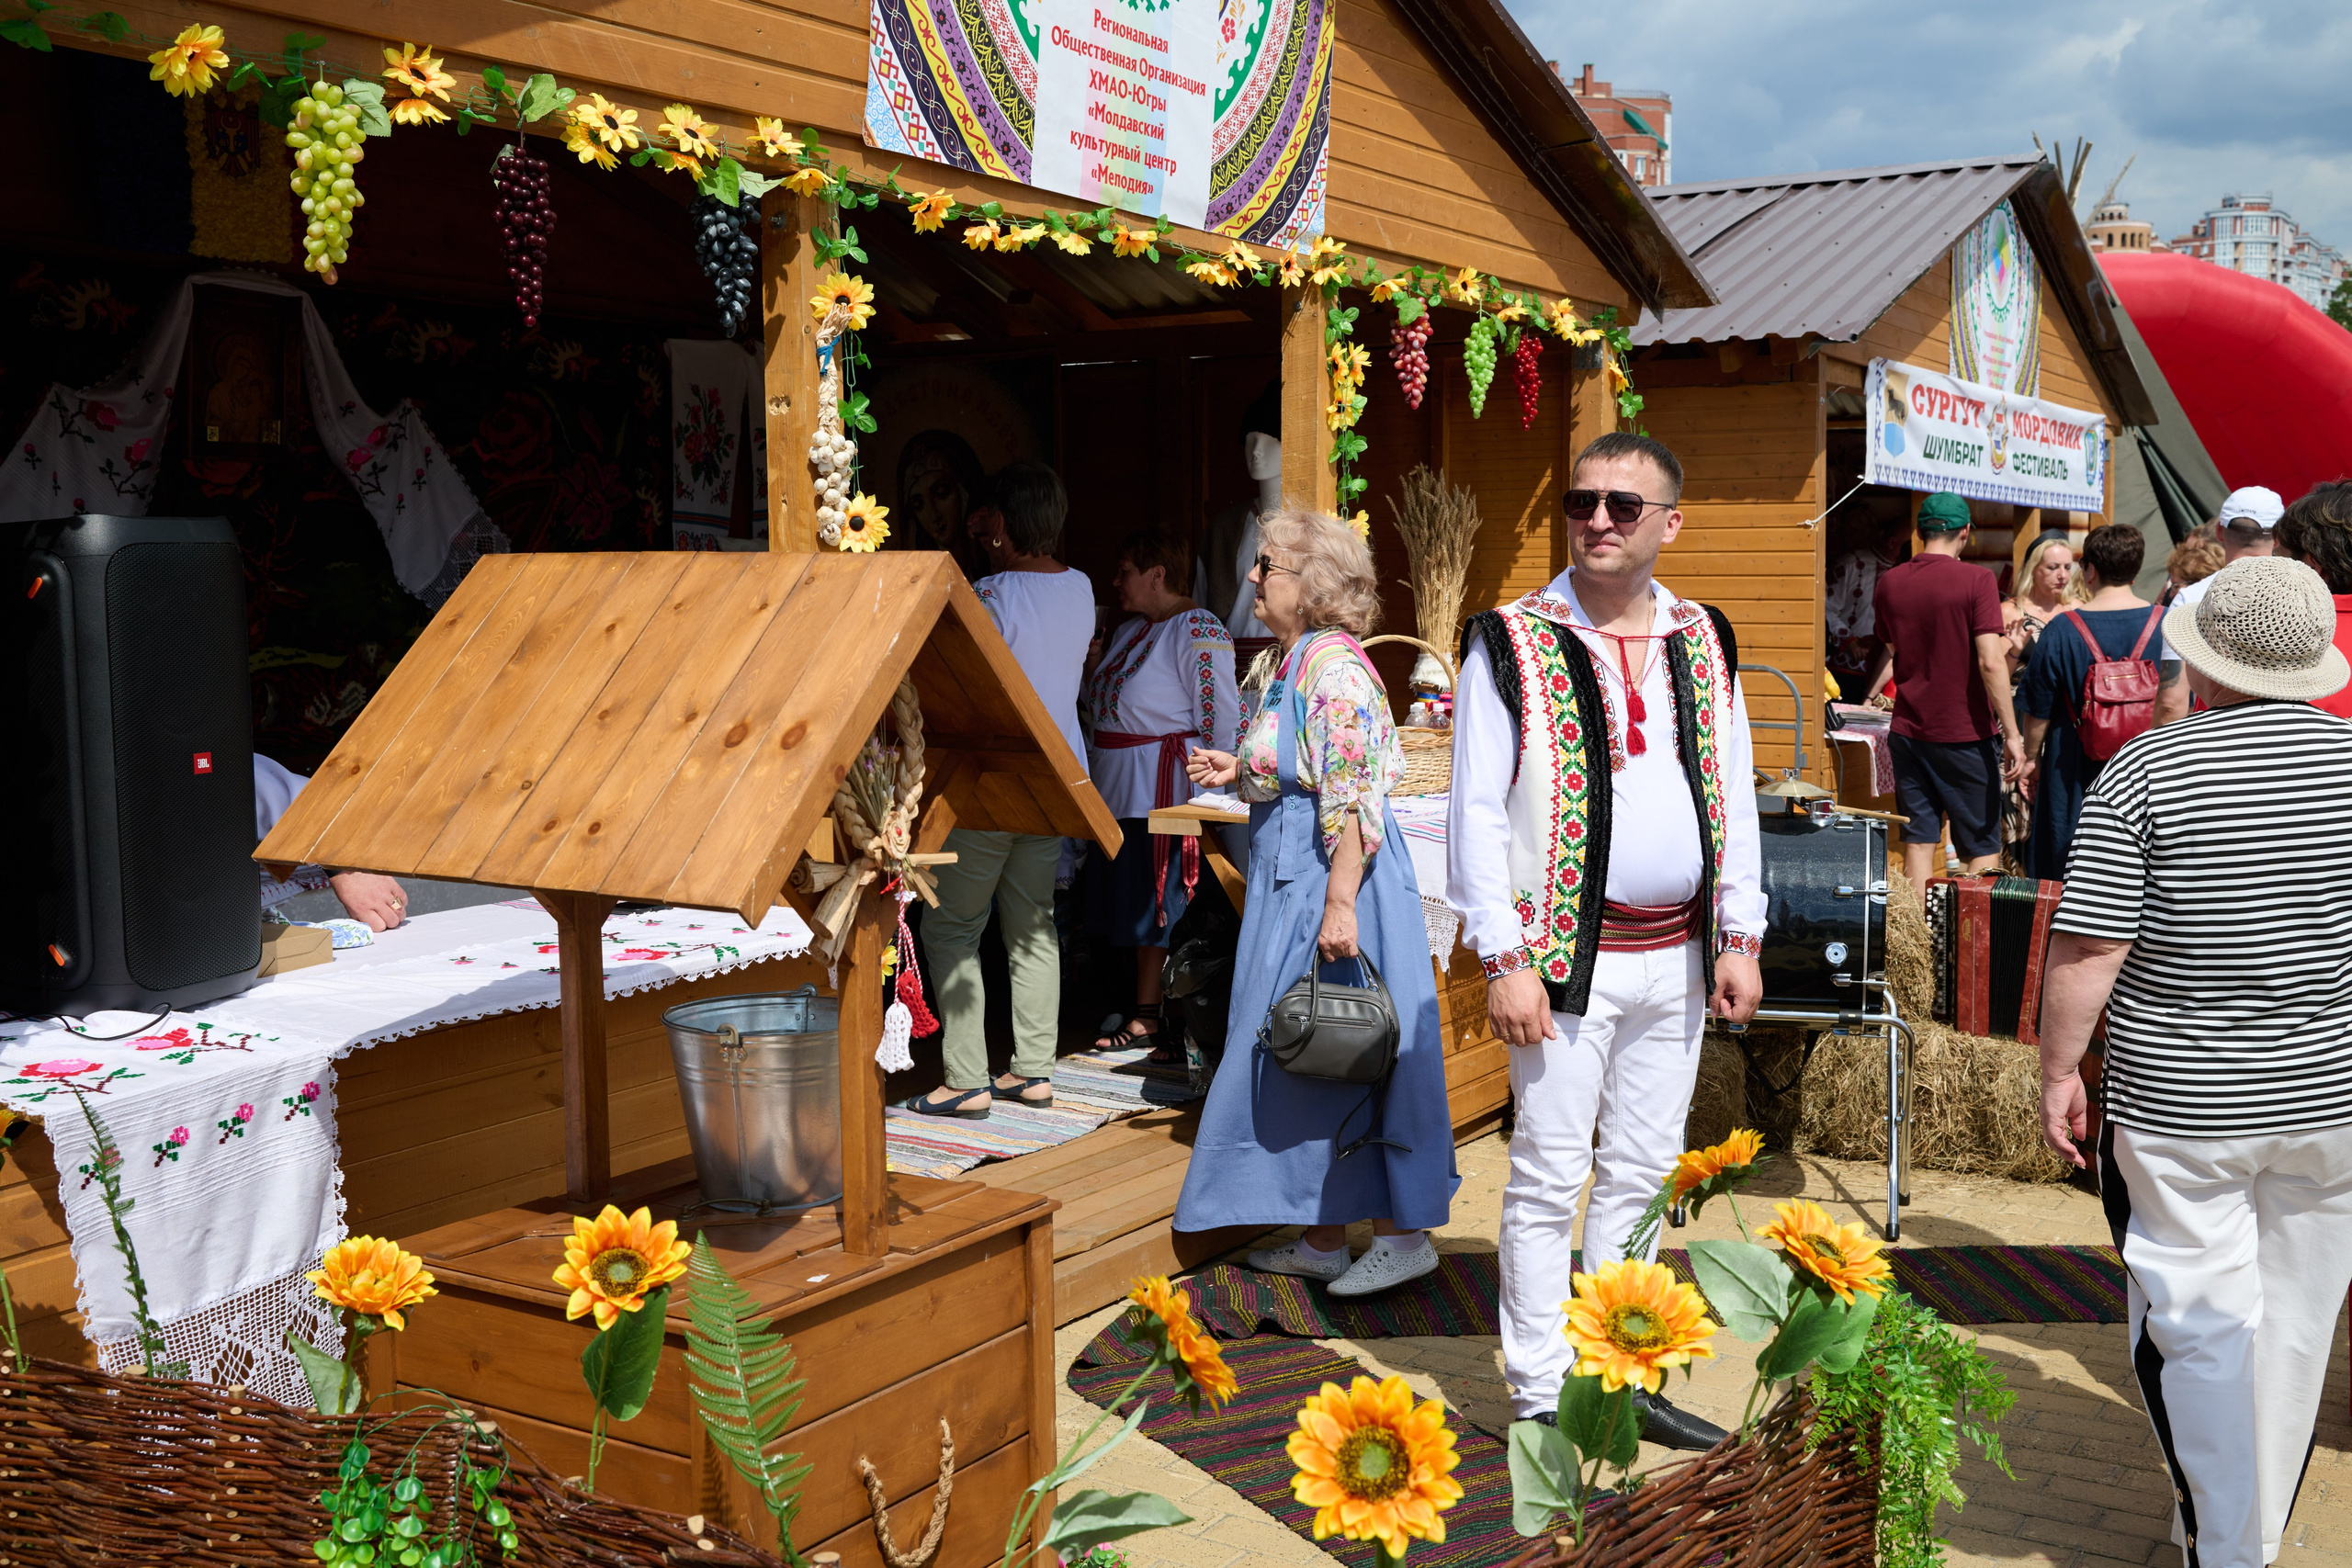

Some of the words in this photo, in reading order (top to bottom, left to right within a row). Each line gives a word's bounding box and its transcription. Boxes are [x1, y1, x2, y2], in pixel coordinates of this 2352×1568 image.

[1093, 8, 1169, 53] Региональная
[1051, 25, 1137, 73] Общественная
[1139, 57, 1206, 96] Организация
[1089, 68, 1167, 112] ХМАО-Югры
[1088, 101, 1165, 141] «Молдавский
[1069, 130, 1141, 164] культурный
[1144, 152, 1177, 176] центр
[1091, 163, 1154, 195] «Мелодия»
[1911, 383, 1985, 428] СУРГУТ
[2012, 410, 2085, 450] МОРДОВИЯ
[1923, 434, 1984, 468] ШУМБРАТ
[2012, 452, 2068, 480] ФЕСТИВАЛЬ
